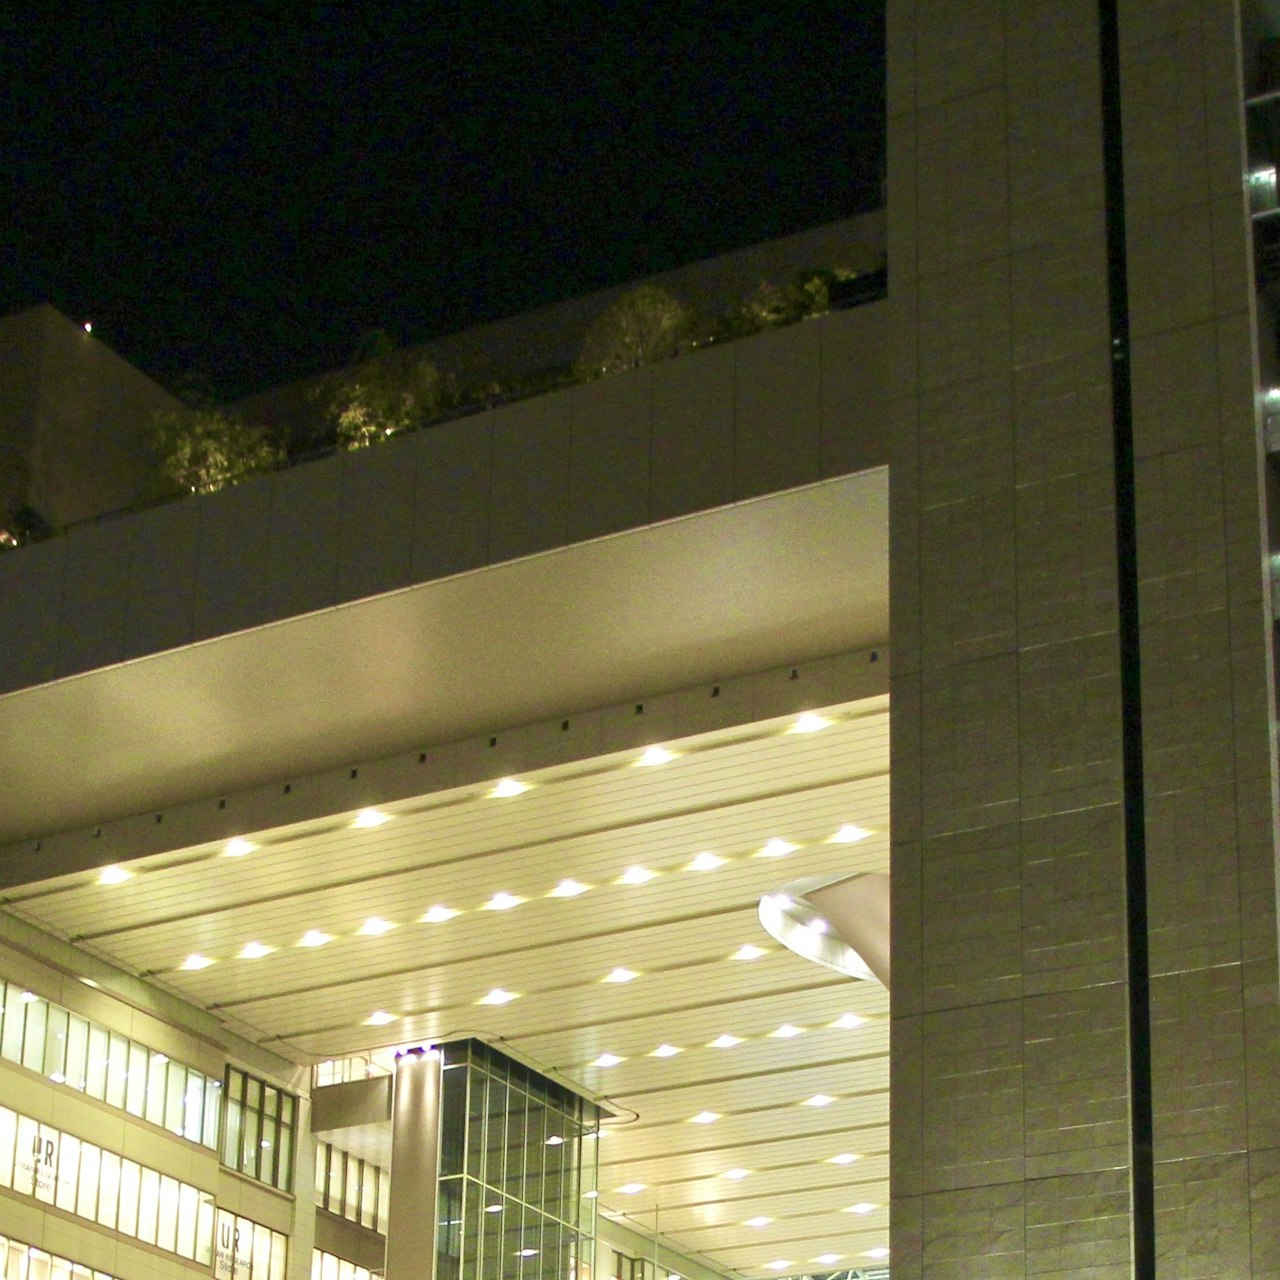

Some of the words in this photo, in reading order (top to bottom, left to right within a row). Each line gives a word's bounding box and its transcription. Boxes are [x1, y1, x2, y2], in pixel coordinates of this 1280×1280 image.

[32, 1135, 55, 1168] UR
[221, 1222, 241, 1254] UR
[219, 1259, 239, 1276] Stoe
